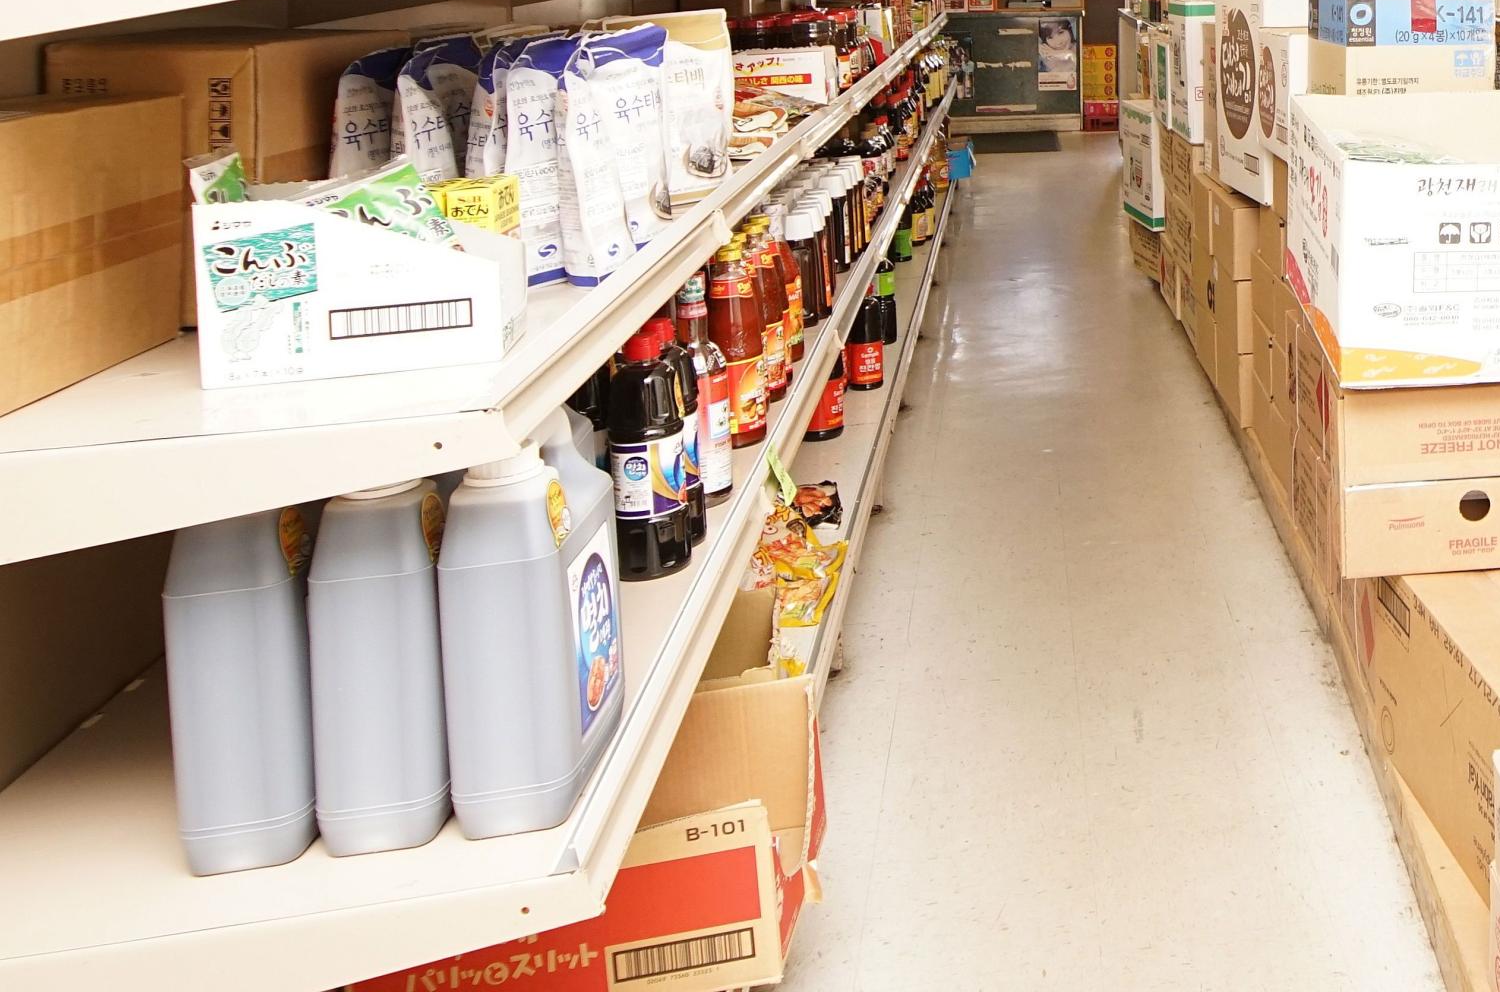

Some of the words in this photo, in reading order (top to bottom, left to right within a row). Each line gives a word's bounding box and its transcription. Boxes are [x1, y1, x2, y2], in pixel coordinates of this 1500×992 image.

[451, 204, 489, 218] おでん
[214, 241, 311, 275] こんぶ
[1420, 440, 1474, 455] FREEZE
[1448, 536, 1498, 550] FRAGILE
[1452, 548, 1462, 556] DO
[685, 819, 747, 842] B-101
